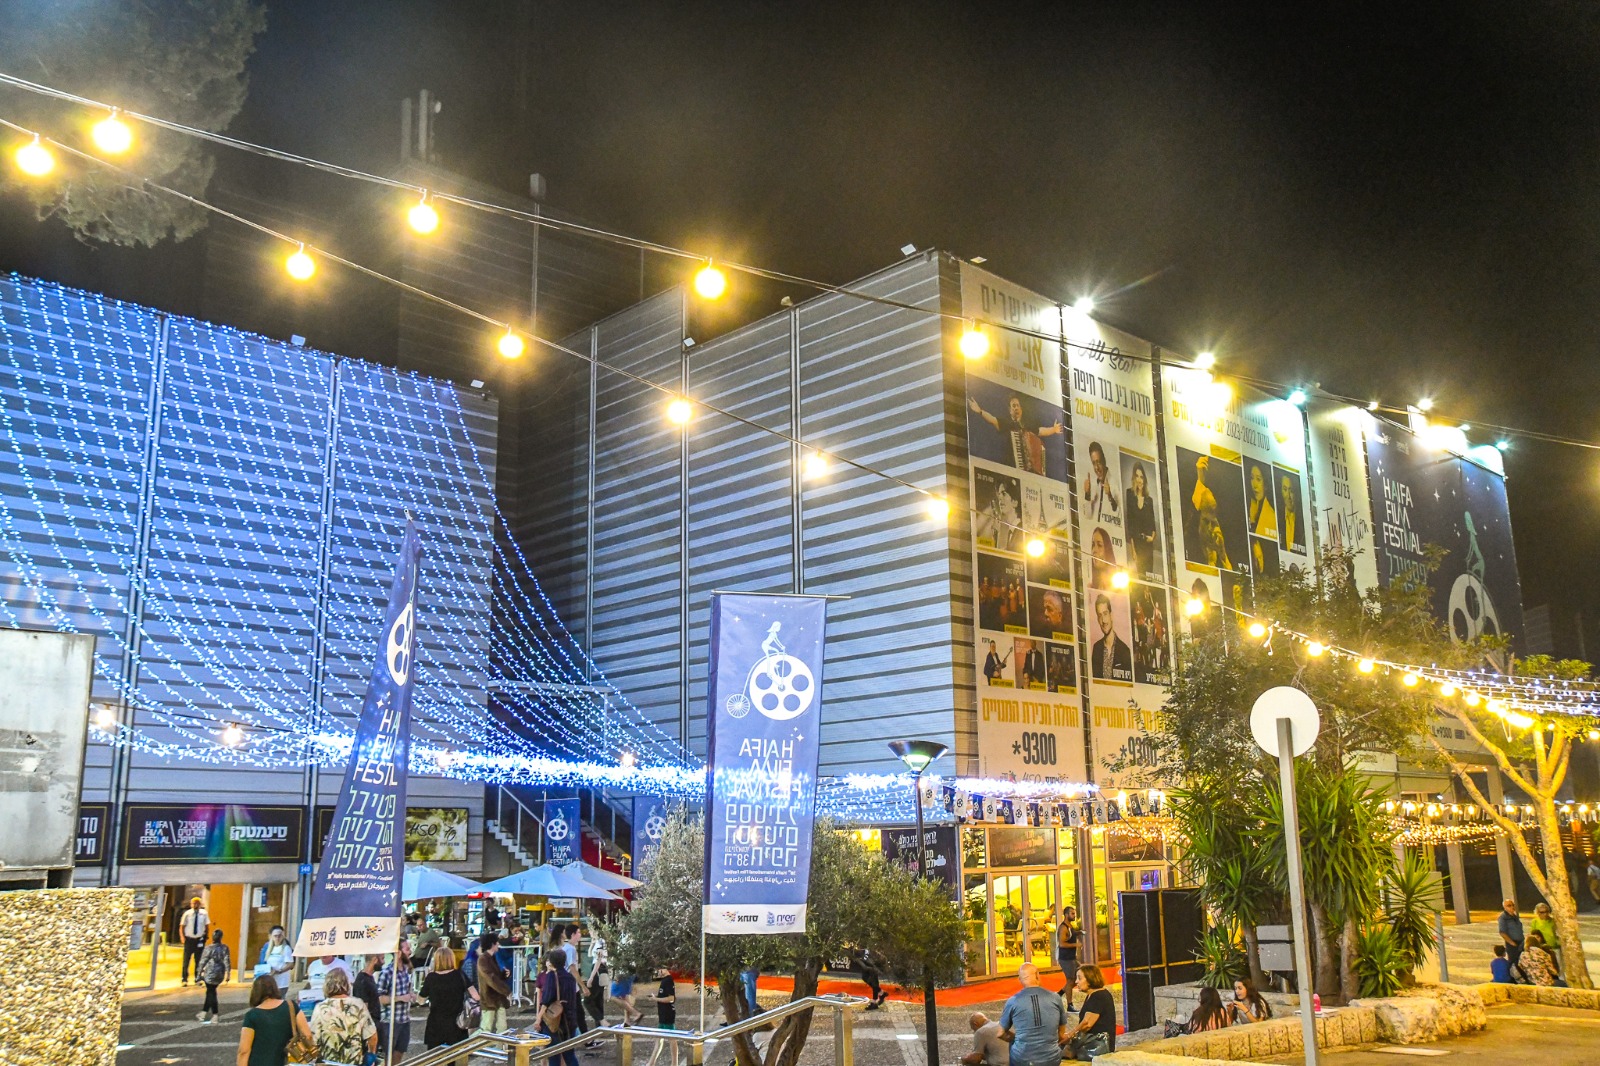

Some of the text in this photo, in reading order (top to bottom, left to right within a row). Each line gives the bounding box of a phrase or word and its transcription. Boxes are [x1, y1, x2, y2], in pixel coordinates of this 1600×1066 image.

[1073, 367, 1096, 396] חיפה
[1098, 377, 1114, 403] בנד
[1130, 390, 1151, 417] סדרת
[1382, 476, 1414, 508] HAIFA
[1385, 500, 1411, 530] FILM
[1382, 521, 1424, 556] FESTIVAL
[982, 697, 1079, 728] החלה מכירת המנויים
[1094, 705, 1126, 730] המנויים
[145, 820, 169, 829] HAIFA
[230, 825, 288, 841] סינמטק
[409, 822, 438, 837] HSO
[139, 836, 171, 845] FESTIVAL
[329, 843, 378, 870] חיפה
[309, 931, 328, 942] חיפה
[344, 930, 365, 940] אתוס
